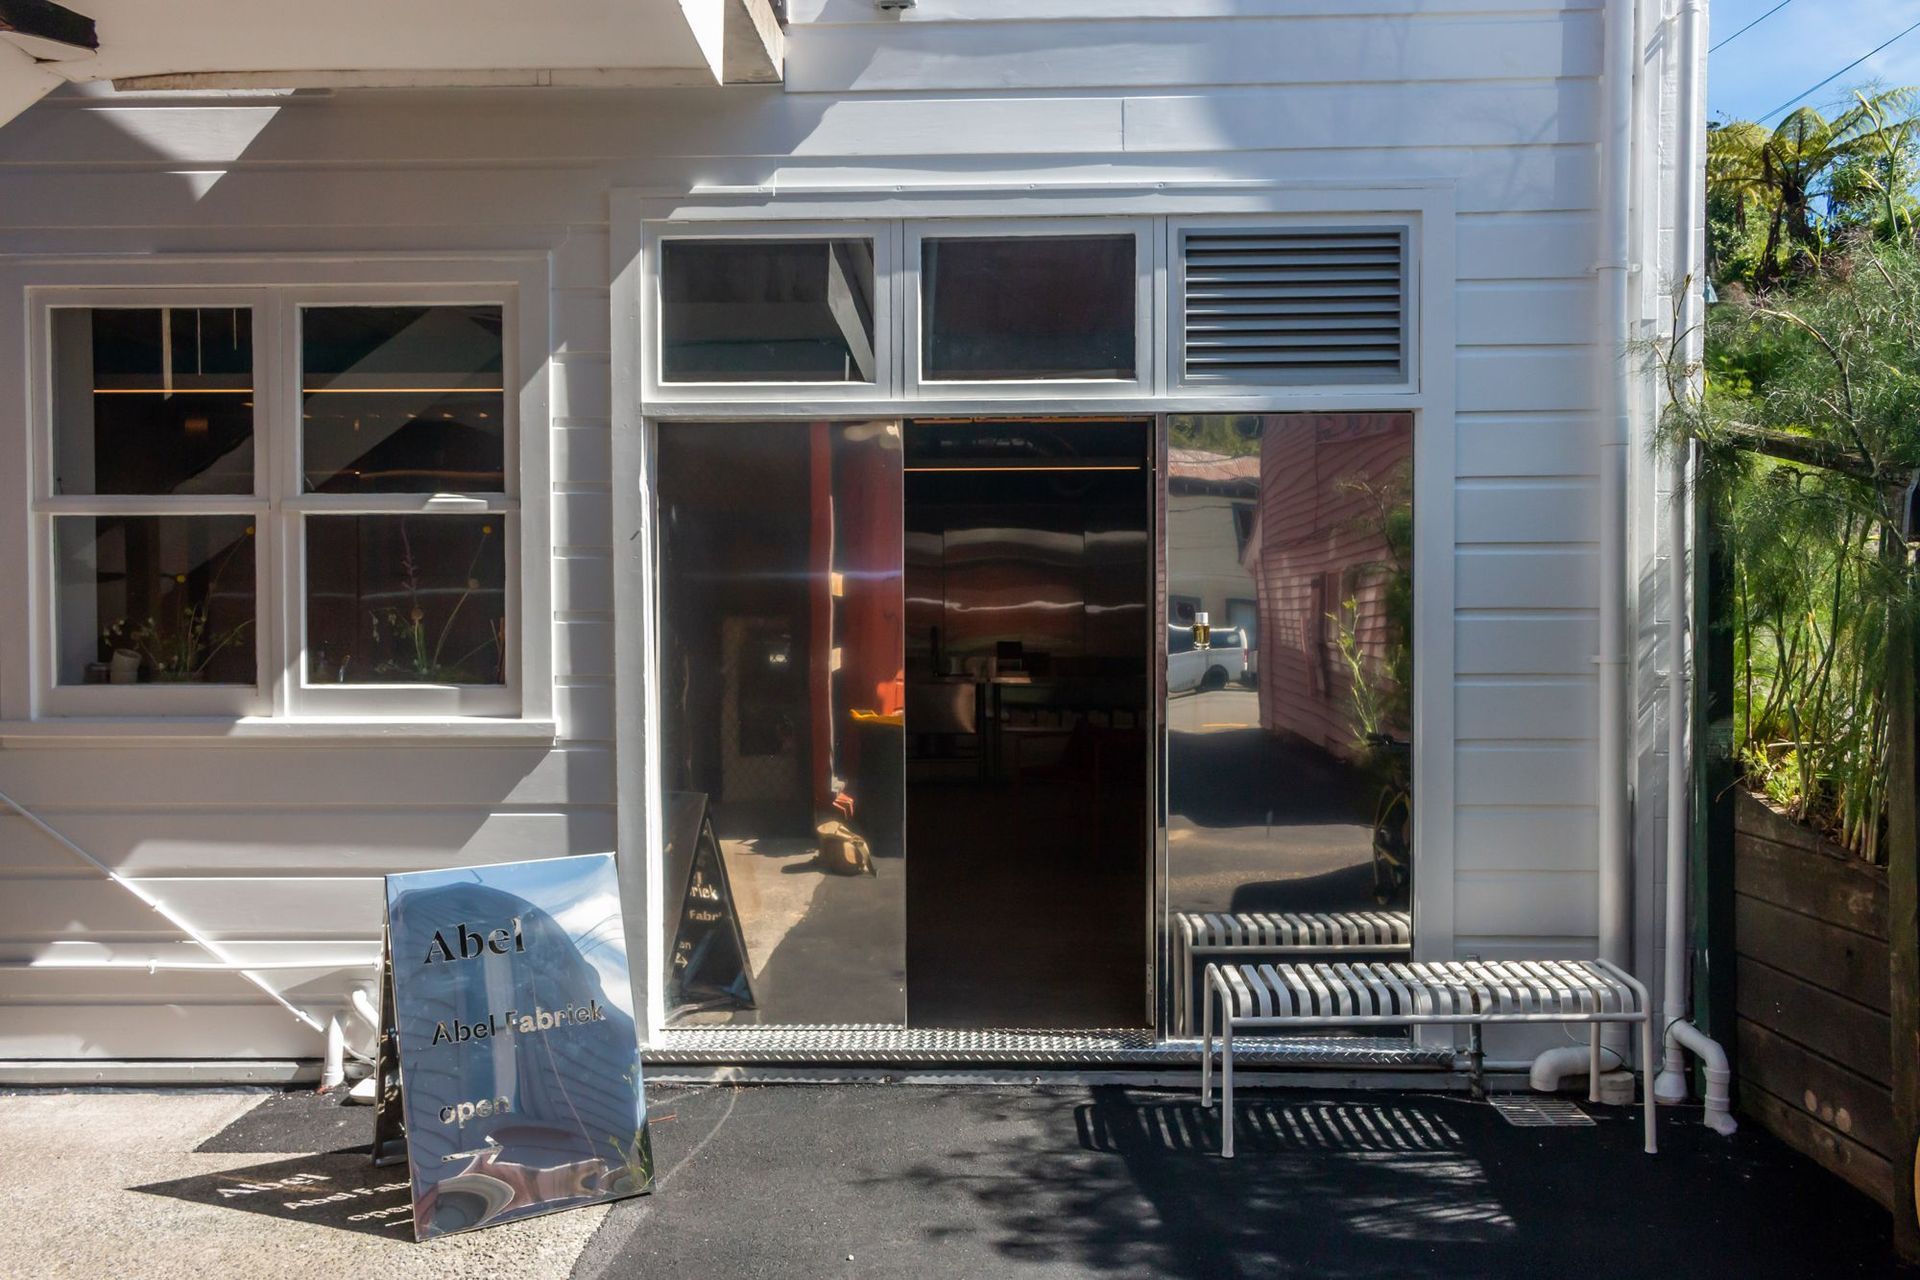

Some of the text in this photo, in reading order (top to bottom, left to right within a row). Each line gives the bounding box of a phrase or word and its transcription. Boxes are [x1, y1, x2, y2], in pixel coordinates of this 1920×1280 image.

[424, 915, 526, 965] Abel
[432, 999, 606, 1045] Abel Fabriek
[439, 1095, 511, 1129] open
